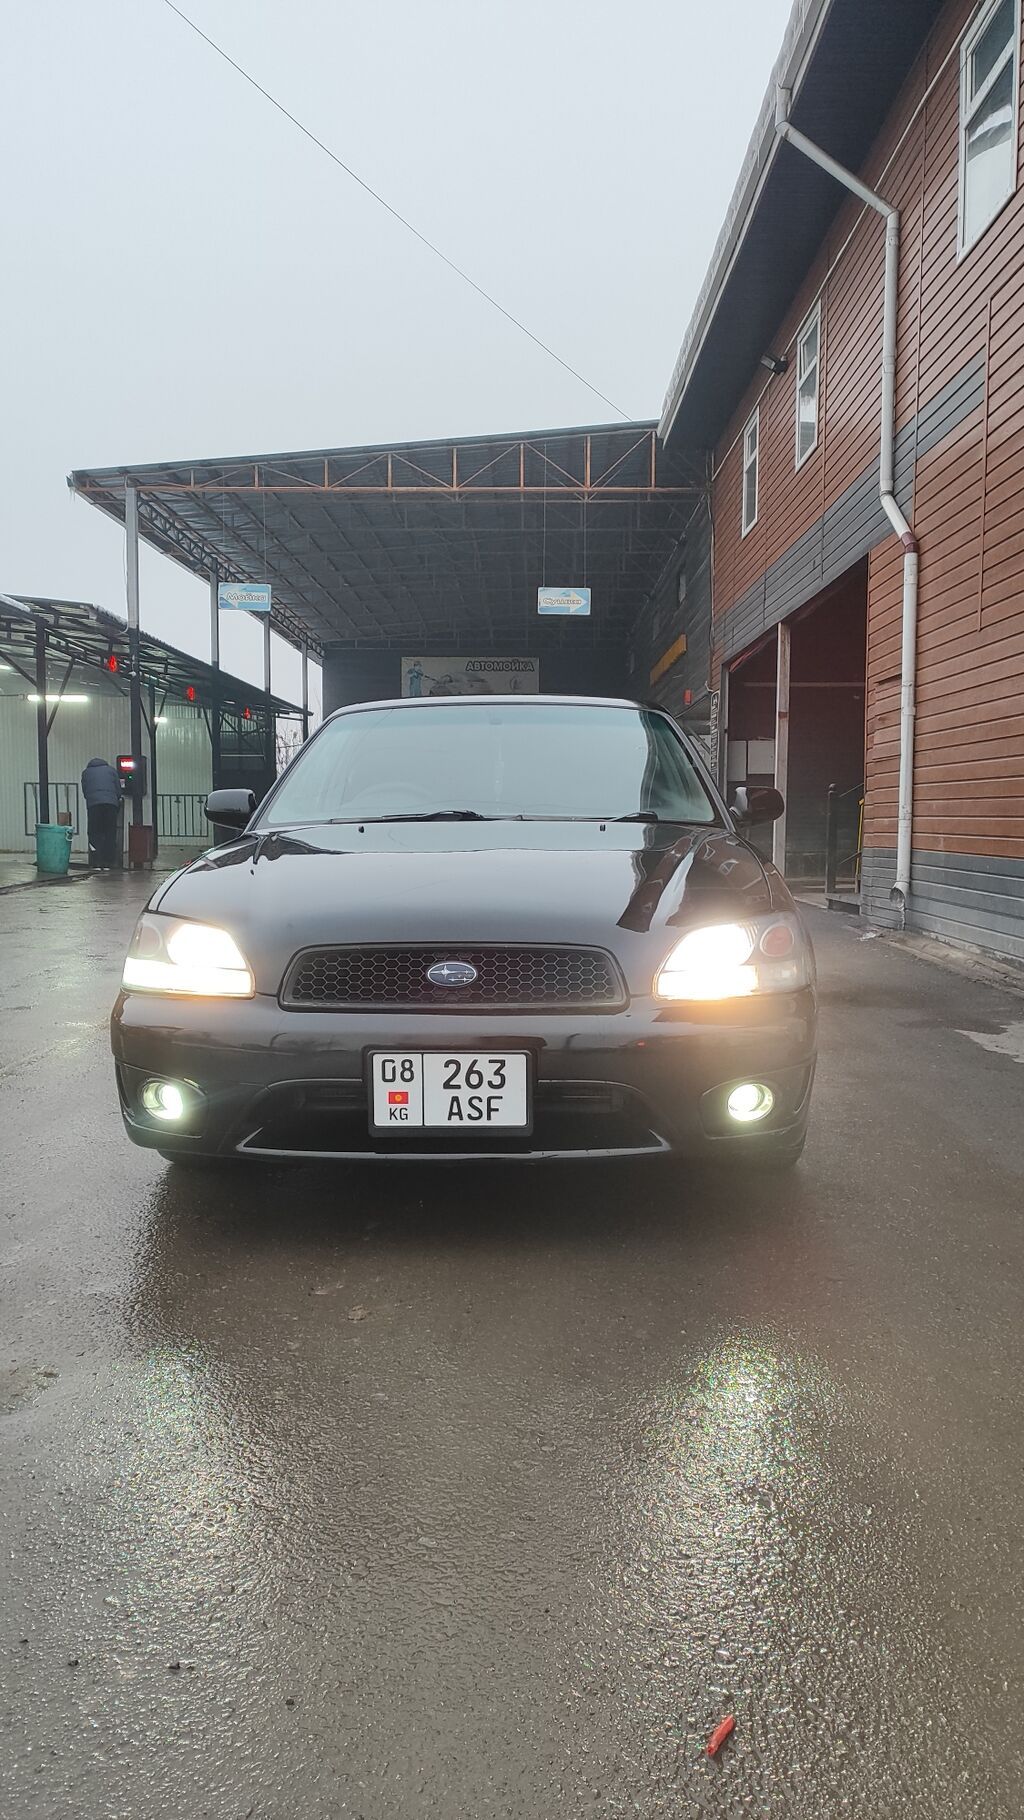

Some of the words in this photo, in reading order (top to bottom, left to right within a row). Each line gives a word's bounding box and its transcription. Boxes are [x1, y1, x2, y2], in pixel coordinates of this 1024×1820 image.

[226, 591, 266, 602] Мойка
[466, 659, 535, 672] АВТОМОЙКА
[381, 1059, 414, 1083] 08
[442, 1059, 506, 1090] 263
[389, 1107, 409, 1121] KG
[447, 1095, 503, 1121] ASF
